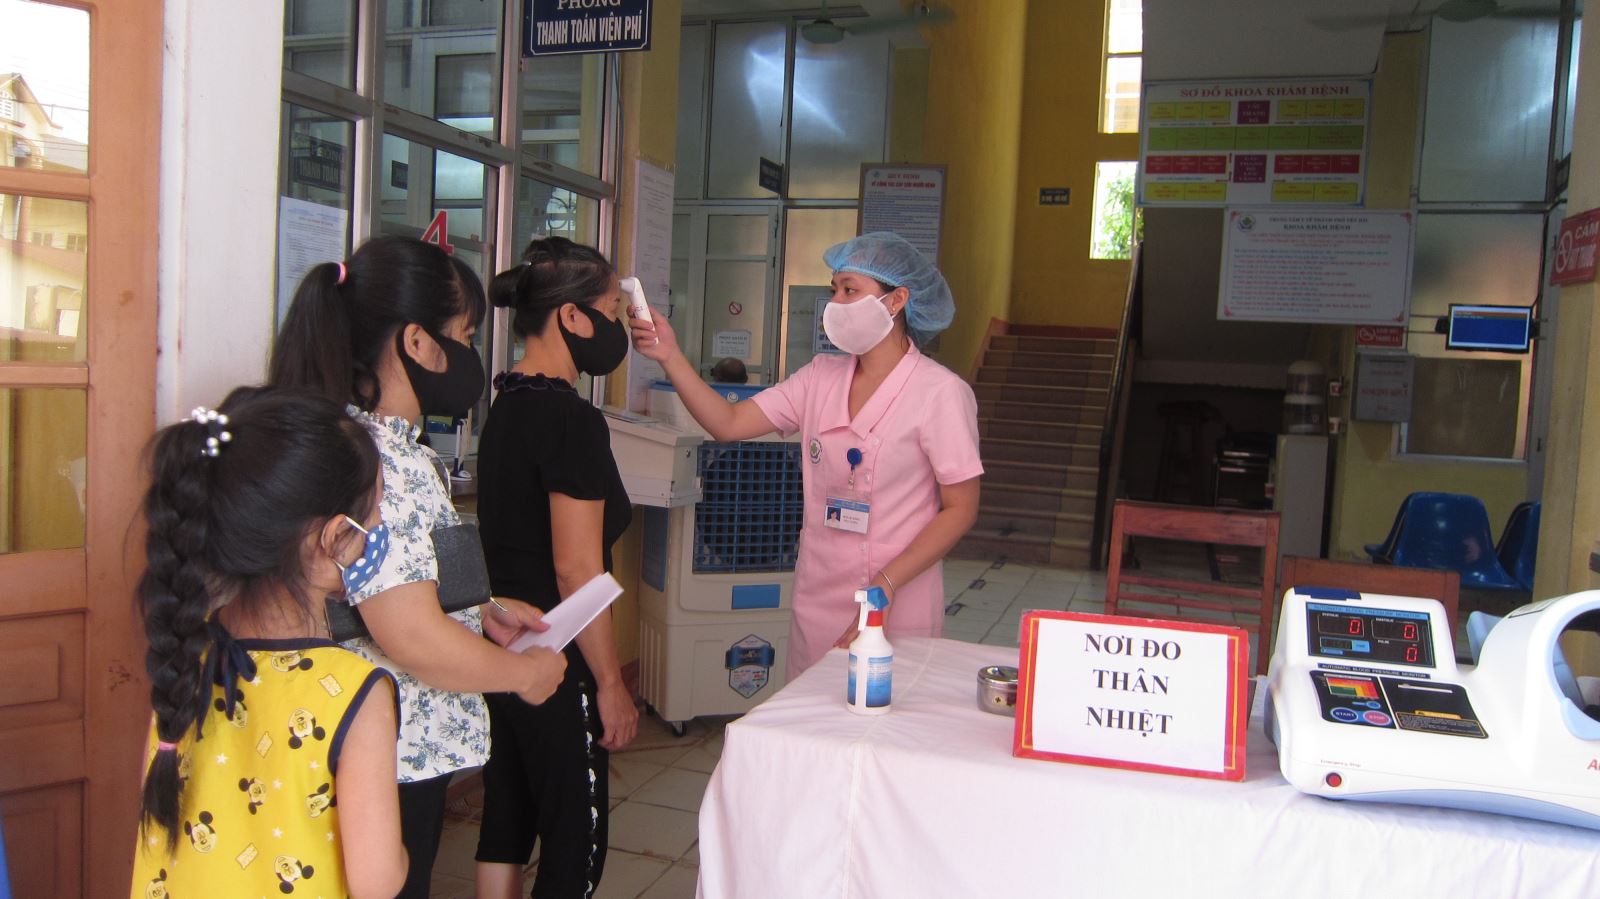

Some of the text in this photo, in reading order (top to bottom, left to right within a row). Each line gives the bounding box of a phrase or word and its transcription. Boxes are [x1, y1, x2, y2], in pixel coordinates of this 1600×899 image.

[537, 9, 642, 47] THANH TOÁN VIỆN PHÍ
[1225, 86, 1263, 98] KHOA
[1266, 84, 1306, 97] KHÁM
[1311, 82, 1350, 97] BỆNH
[420, 208, 455, 255] 4
[1349, 619, 1361, 634] 0
[1404, 624, 1415, 639] 0
[1084, 632, 1182, 661] NƠI ĐO
[1406, 647, 1418, 662] 0
[1092, 667, 1169, 696] THÂN
[1085, 706, 1173, 738] NHIỆT
